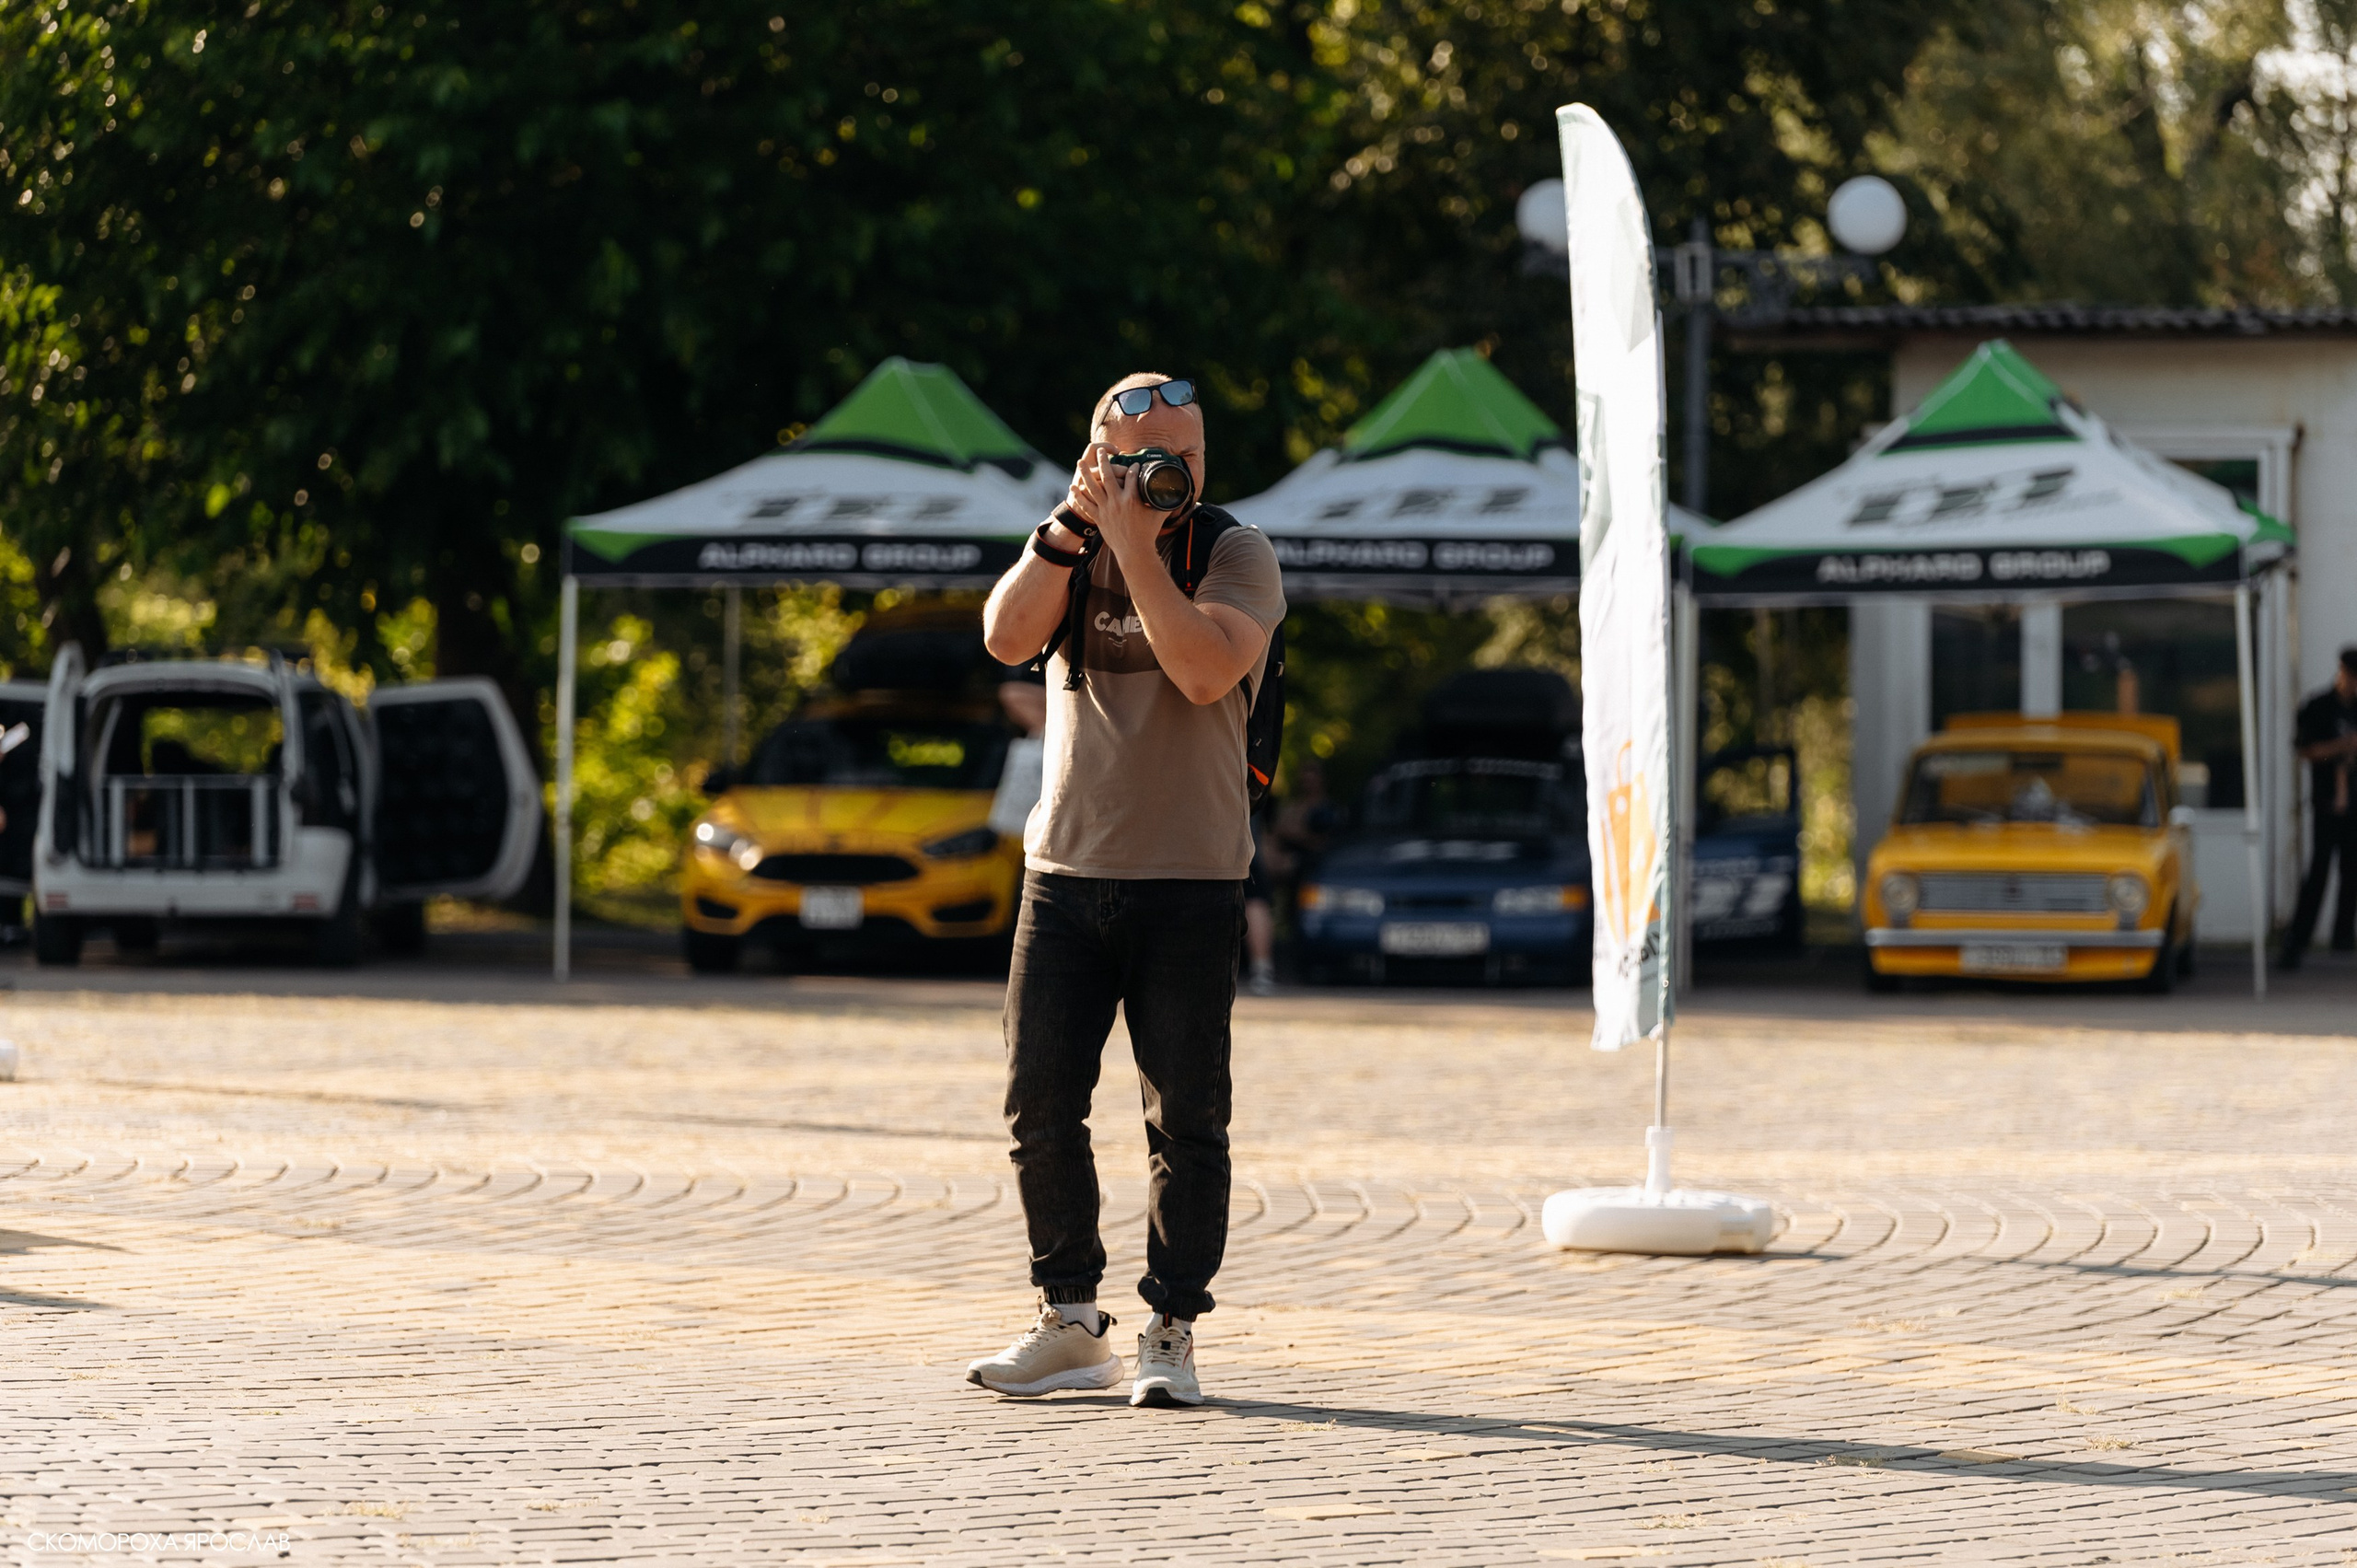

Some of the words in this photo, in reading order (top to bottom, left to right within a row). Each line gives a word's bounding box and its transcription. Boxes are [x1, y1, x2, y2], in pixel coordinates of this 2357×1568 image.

[862, 543, 982, 571] GROUP
[1433, 541, 1555, 570] GROUP
[1989, 551, 2111, 580] GROUP
